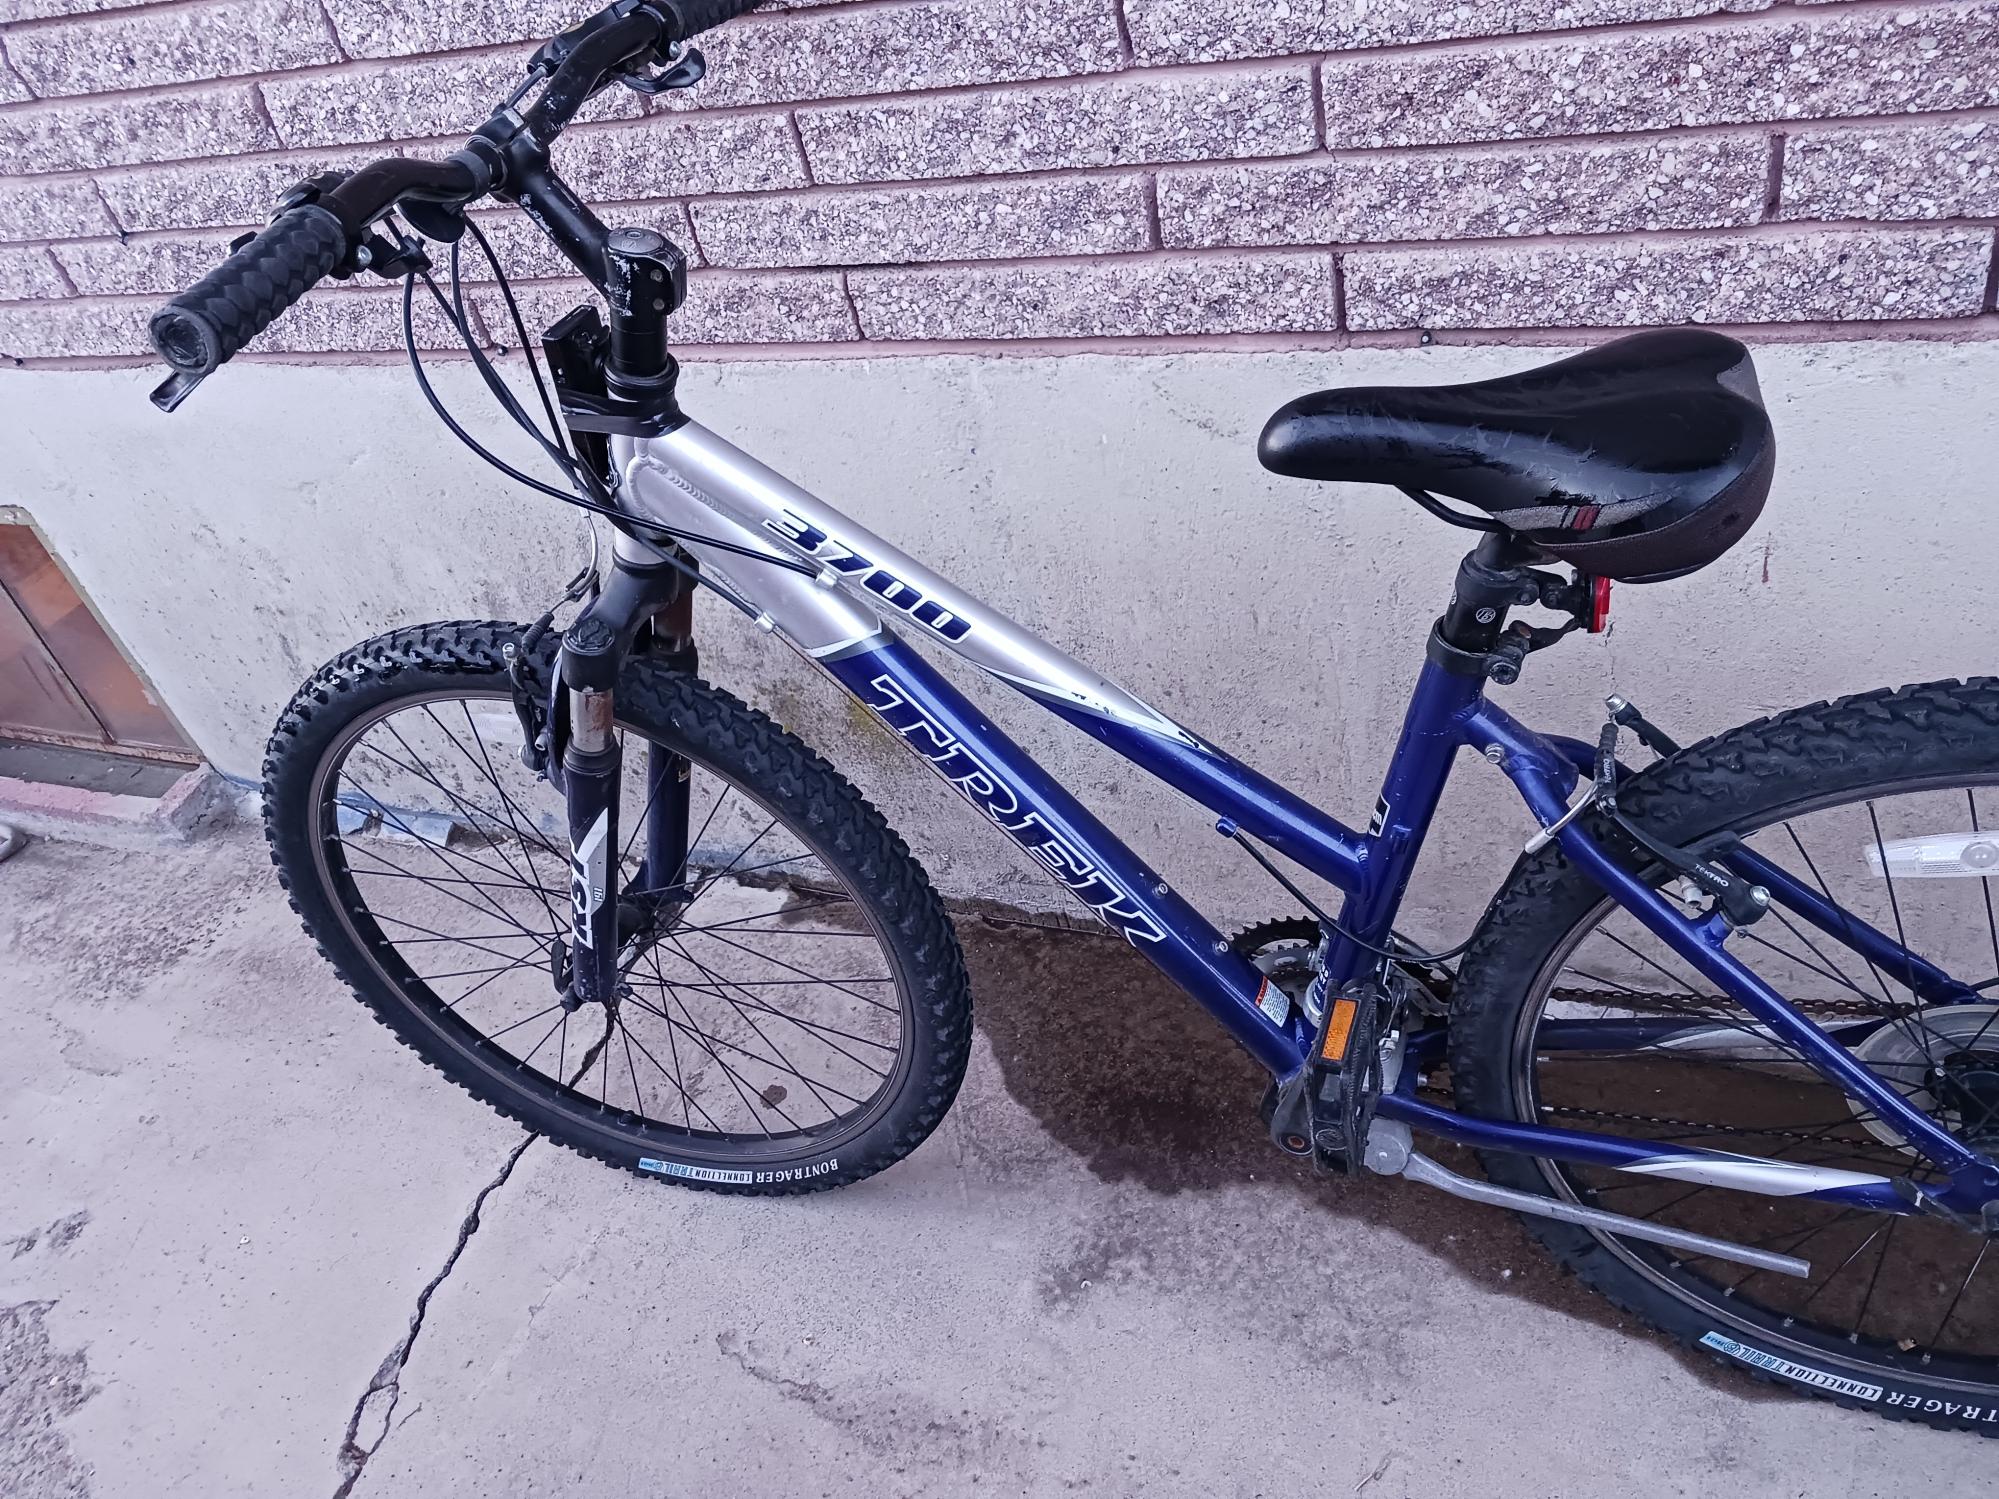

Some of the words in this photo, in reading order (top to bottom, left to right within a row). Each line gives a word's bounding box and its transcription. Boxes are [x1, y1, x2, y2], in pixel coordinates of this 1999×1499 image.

[761, 508, 972, 643] 3700
[868, 673, 1168, 948] TREK
[1695, 863, 1729, 887] TEKTRO
[664, 1163, 694, 1177] TRAIL
[694, 1169, 751, 1183] CONNECTION
[756, 1158, 839, 1183] BONTRAGER
[1740, 1347, 1784, 1373] TRAIL
[1784, 1364, 1882, 1401] CONNECTION
